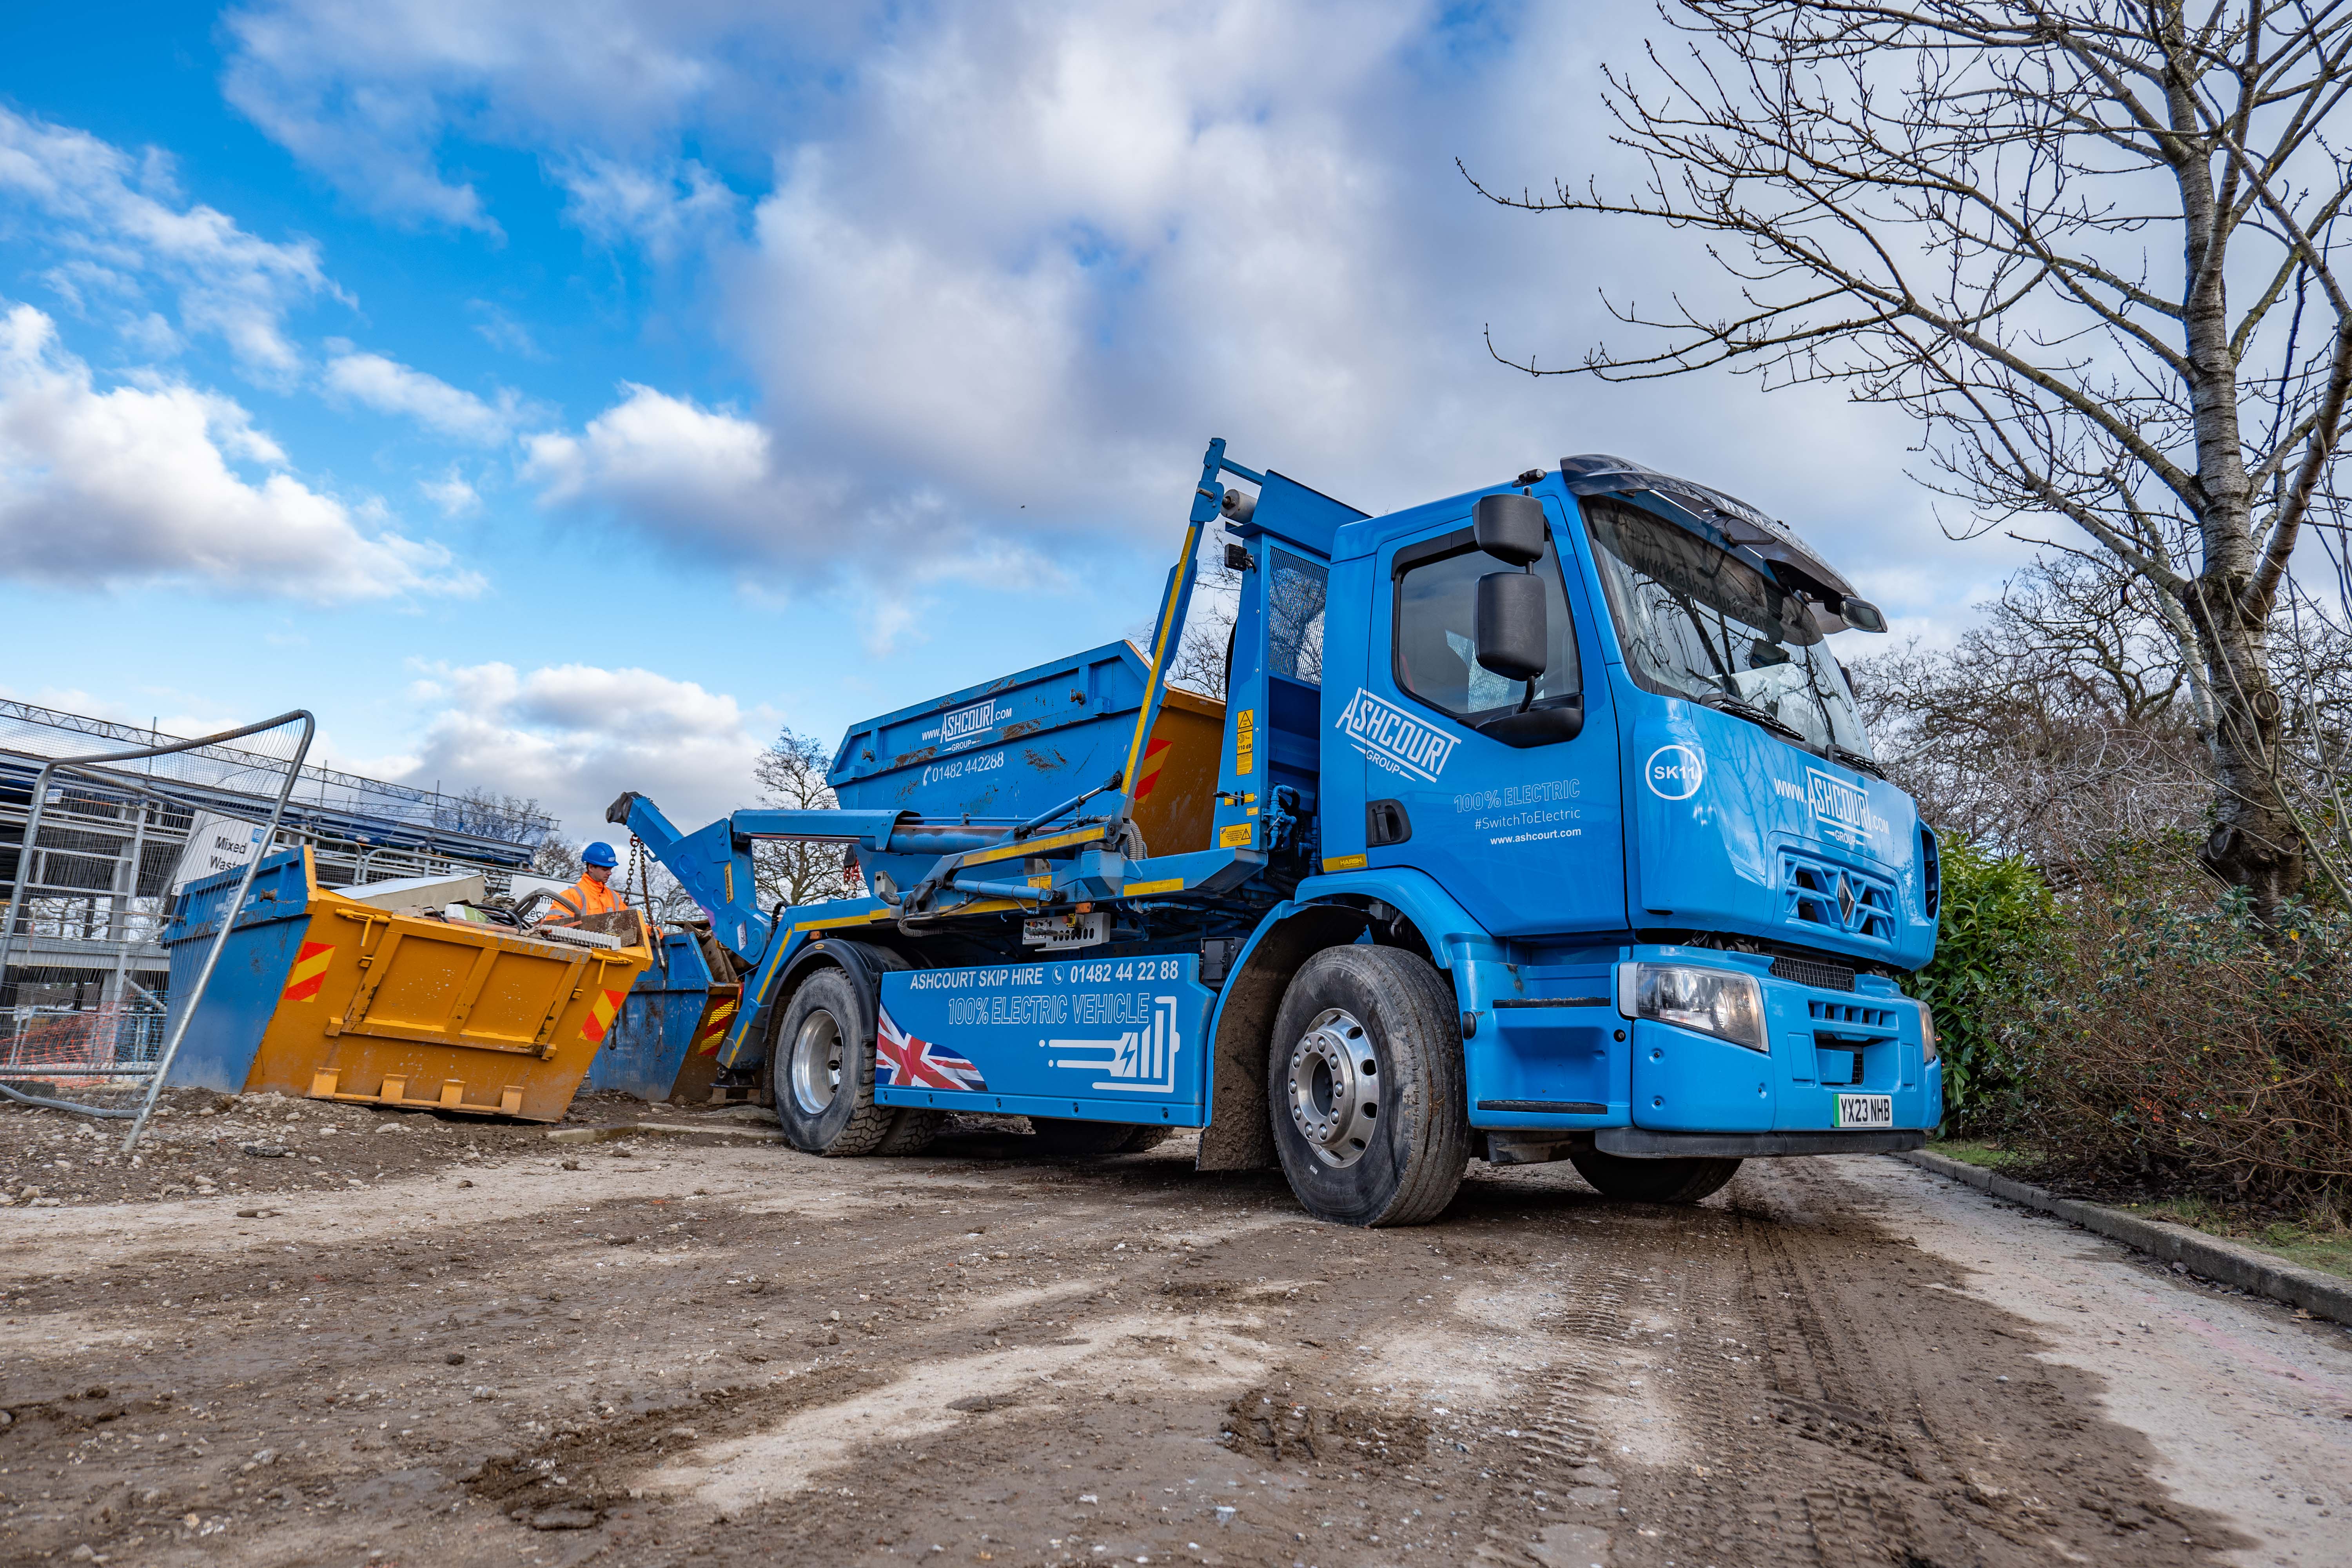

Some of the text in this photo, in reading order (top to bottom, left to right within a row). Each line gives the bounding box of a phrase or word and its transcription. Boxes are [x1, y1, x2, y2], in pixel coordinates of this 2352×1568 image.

[951, 739, 972, 751] GROUP
[1335, 687, 1462, 783] ASHCOURT
[933, 751, 1004, 782] 01482 442288
[1366, 749, 1401, 774] GROUP
[1654, 766, 1697, 780] SK11
[1454, 779, 1580, 813] 100% ELECTRIC
[1475, 809, 1581, 830] #SwitchToElectric
[215, 836, 247, 854] Mixed
[1490, 829, 1581, 845] www.ashcourt.com
[1835, 829, 1855, 846] GROUP
[210, 855, 240, 870] Wast
[910, 960, 1178, 989] ASHCOURT SKIP HIRE 01482 44 22 88
[948, 993, 1150, 1025] 100% ELECTRIC VEHICLE
[1840, 1098, 1890, 1122] YX23 NHB
